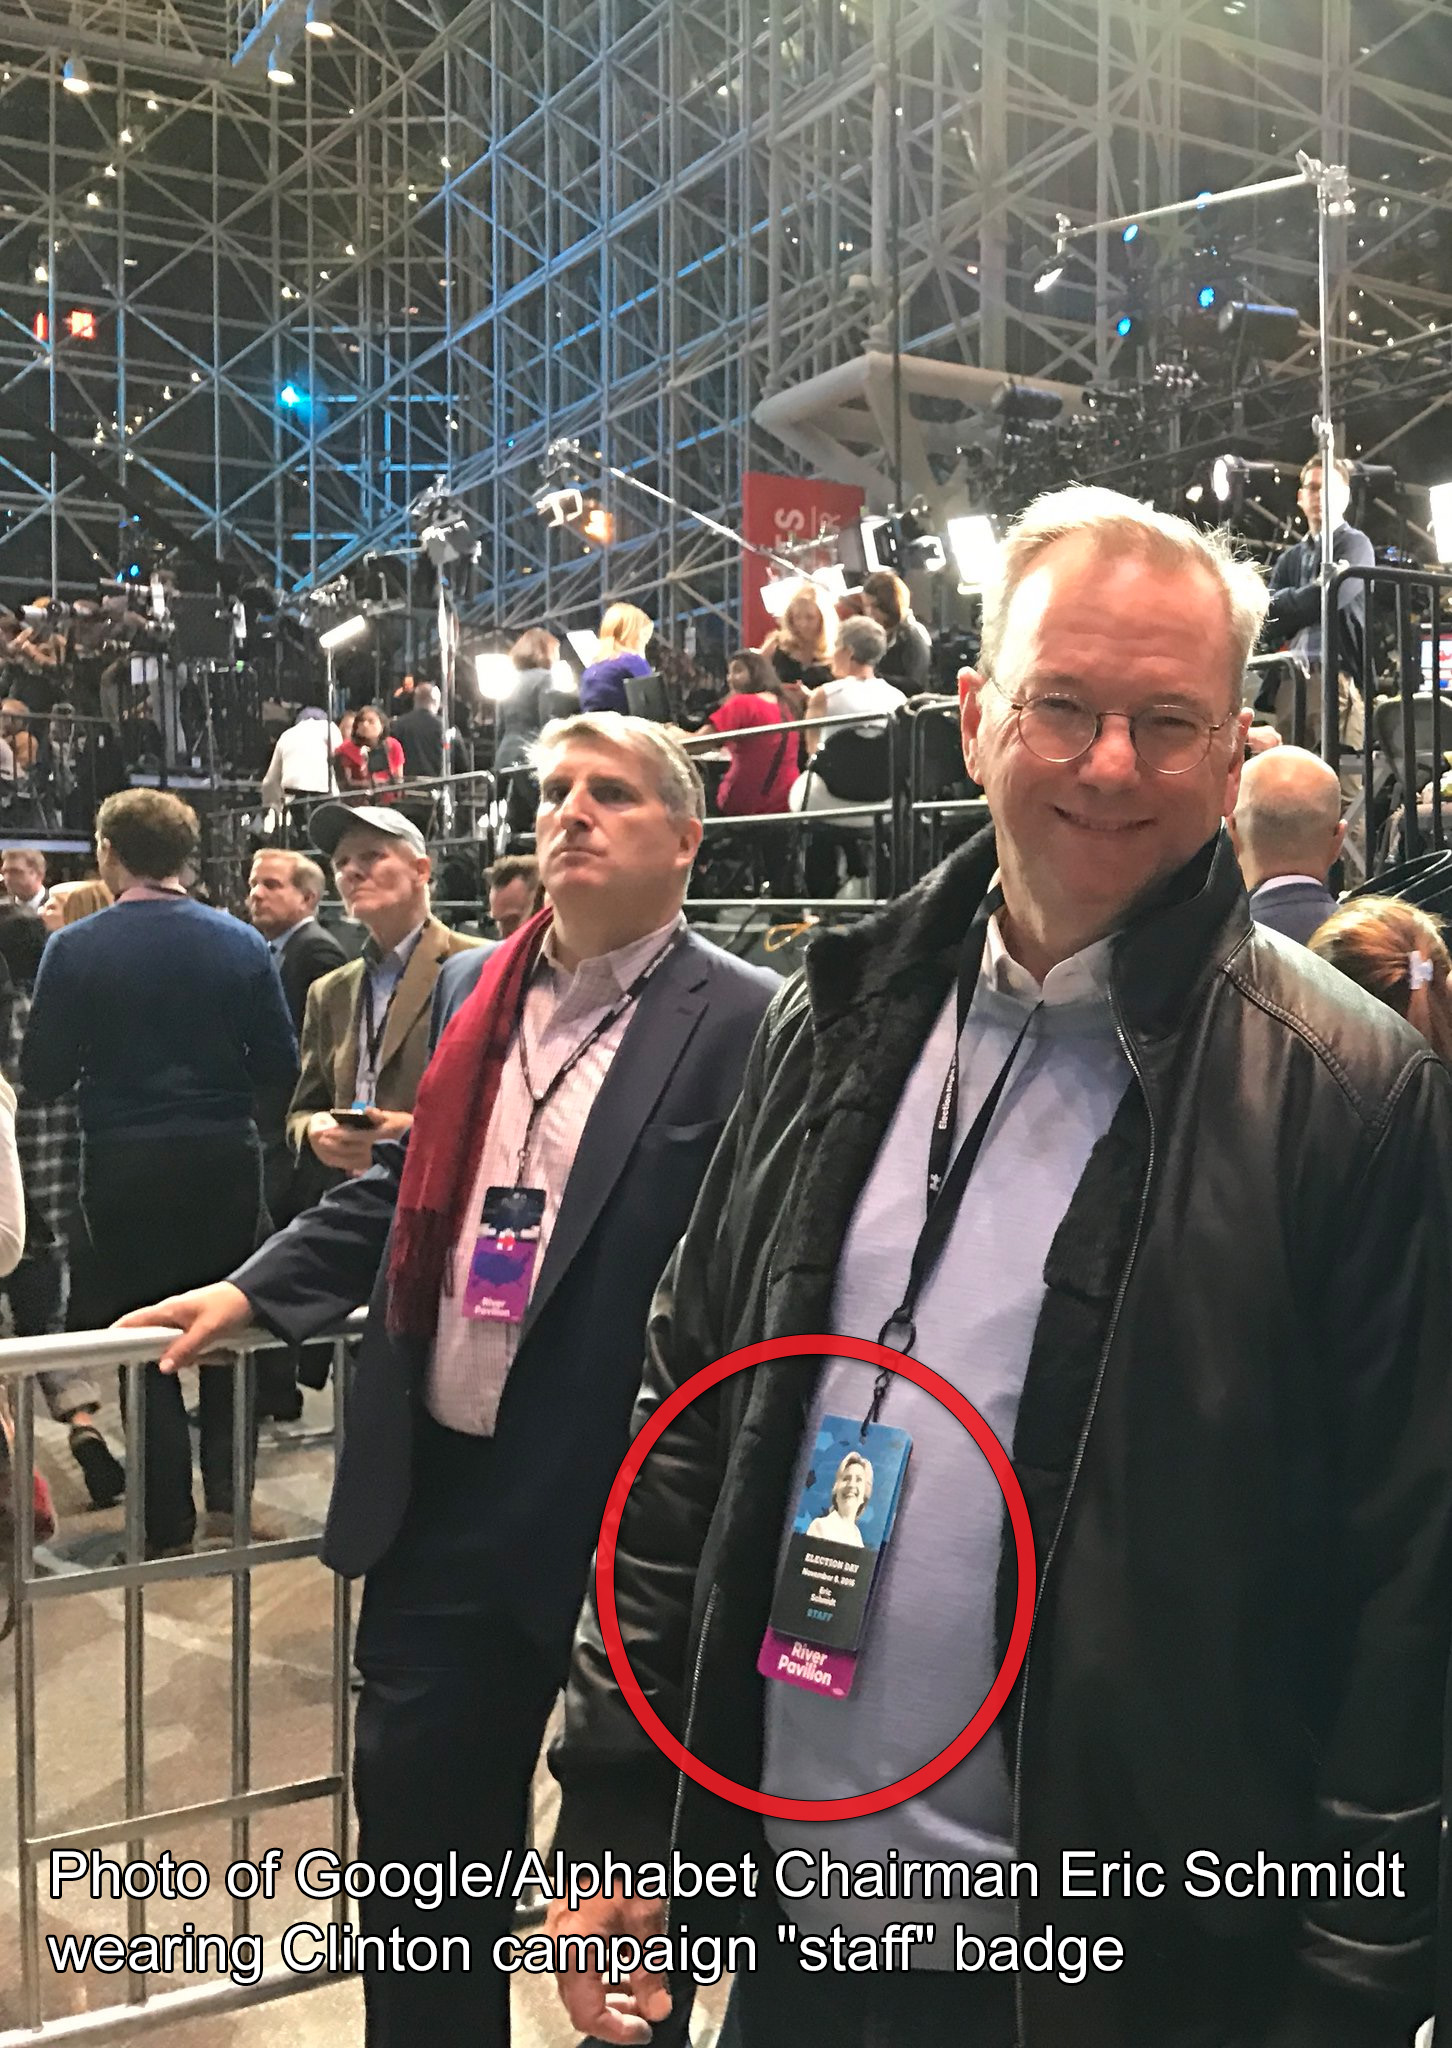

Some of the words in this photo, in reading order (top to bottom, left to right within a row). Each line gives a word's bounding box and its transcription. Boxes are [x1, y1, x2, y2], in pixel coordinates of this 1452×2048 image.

[938, 1091, 952, 1130] Election
[804, 1552, 844, 1569] ELECTION
[843, 1562, 860, 1573] DAY
[801, 1567, 833, 1582] November
[806, 1608, 833, 1622] STAFF
[791, 1641, 828, 1666] River
[777, 1654, 832, 1686] Pavilion
